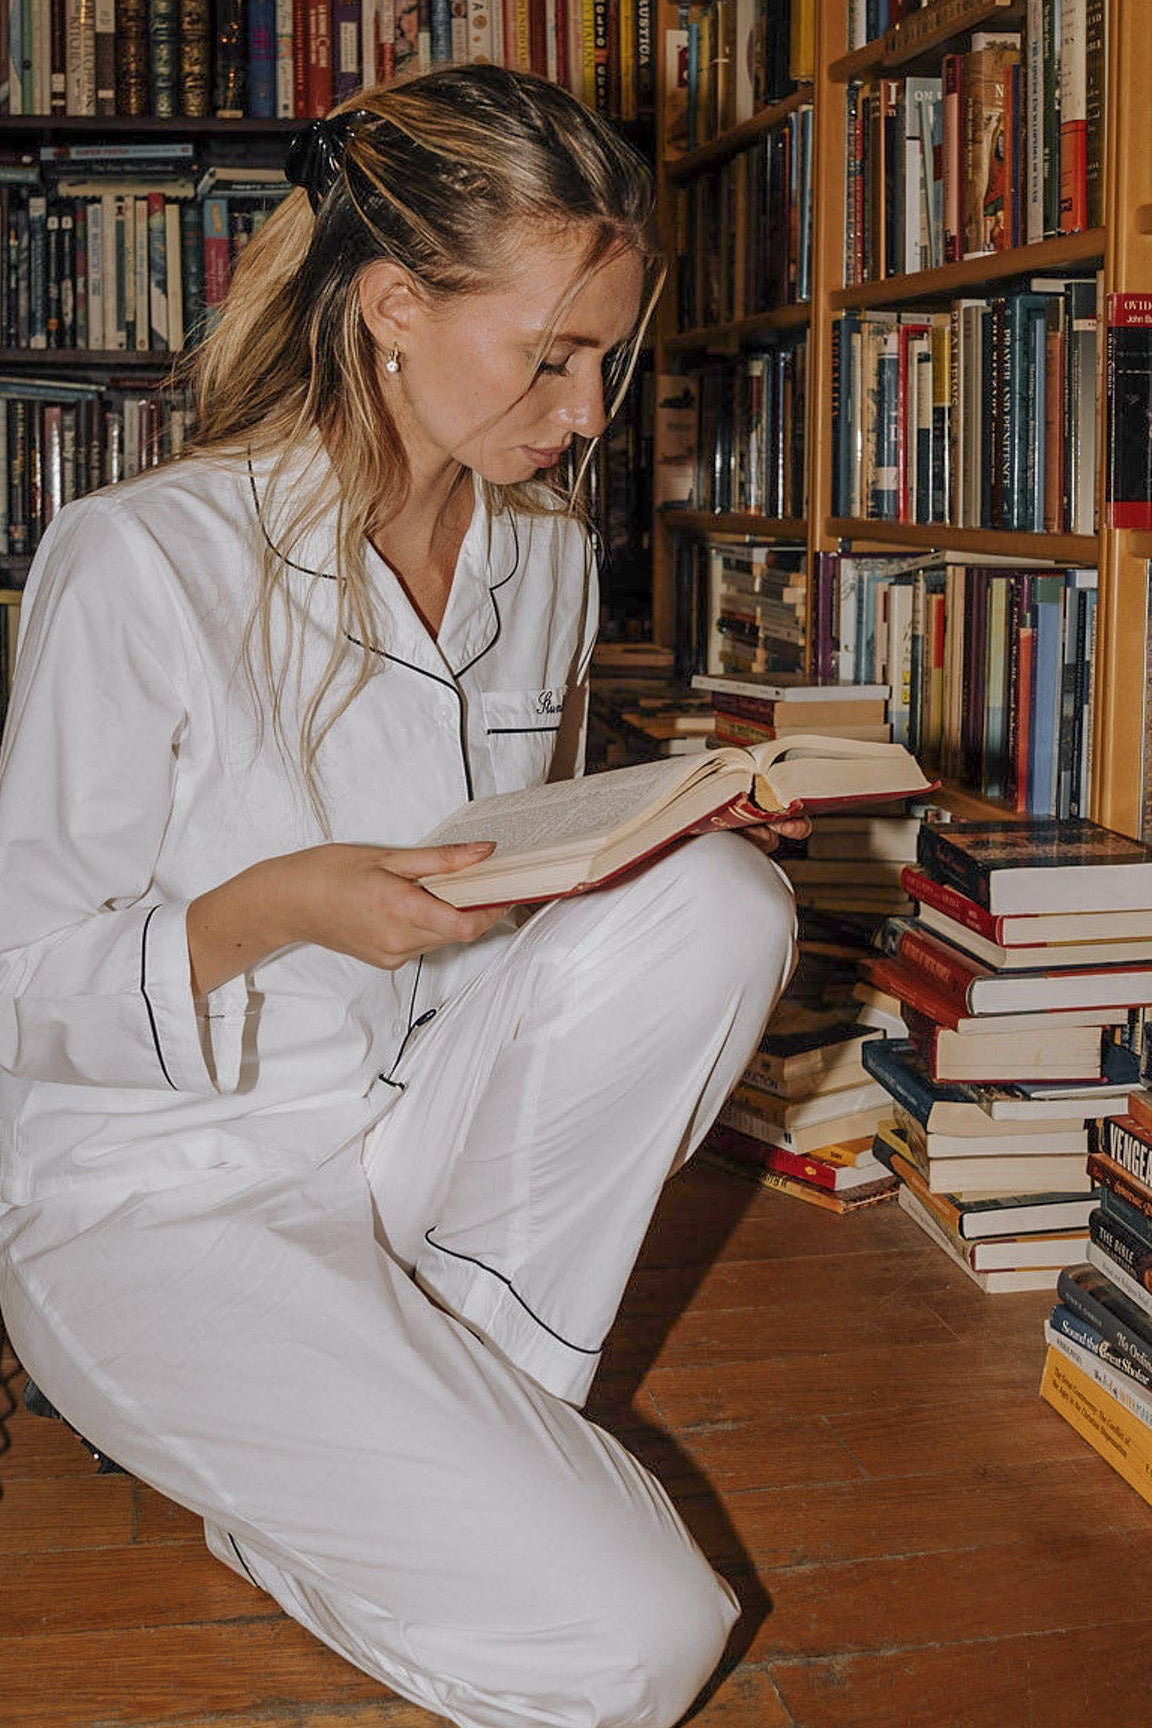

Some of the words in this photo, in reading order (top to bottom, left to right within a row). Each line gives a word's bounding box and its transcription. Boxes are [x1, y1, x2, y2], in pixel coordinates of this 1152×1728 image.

[1126, 315, 1143, 324] John
[1002, 328, 1011, 381] PRAYER
[1002, 386, 1011, 412] AND
[1002, 415, 1011, 488] PENITENCE
[1099, 1226, 1114, 1248] THE
[1114, 1239, 1135, 1265] BIBLE
[1061, 1319, 1087, 1346] Sound
